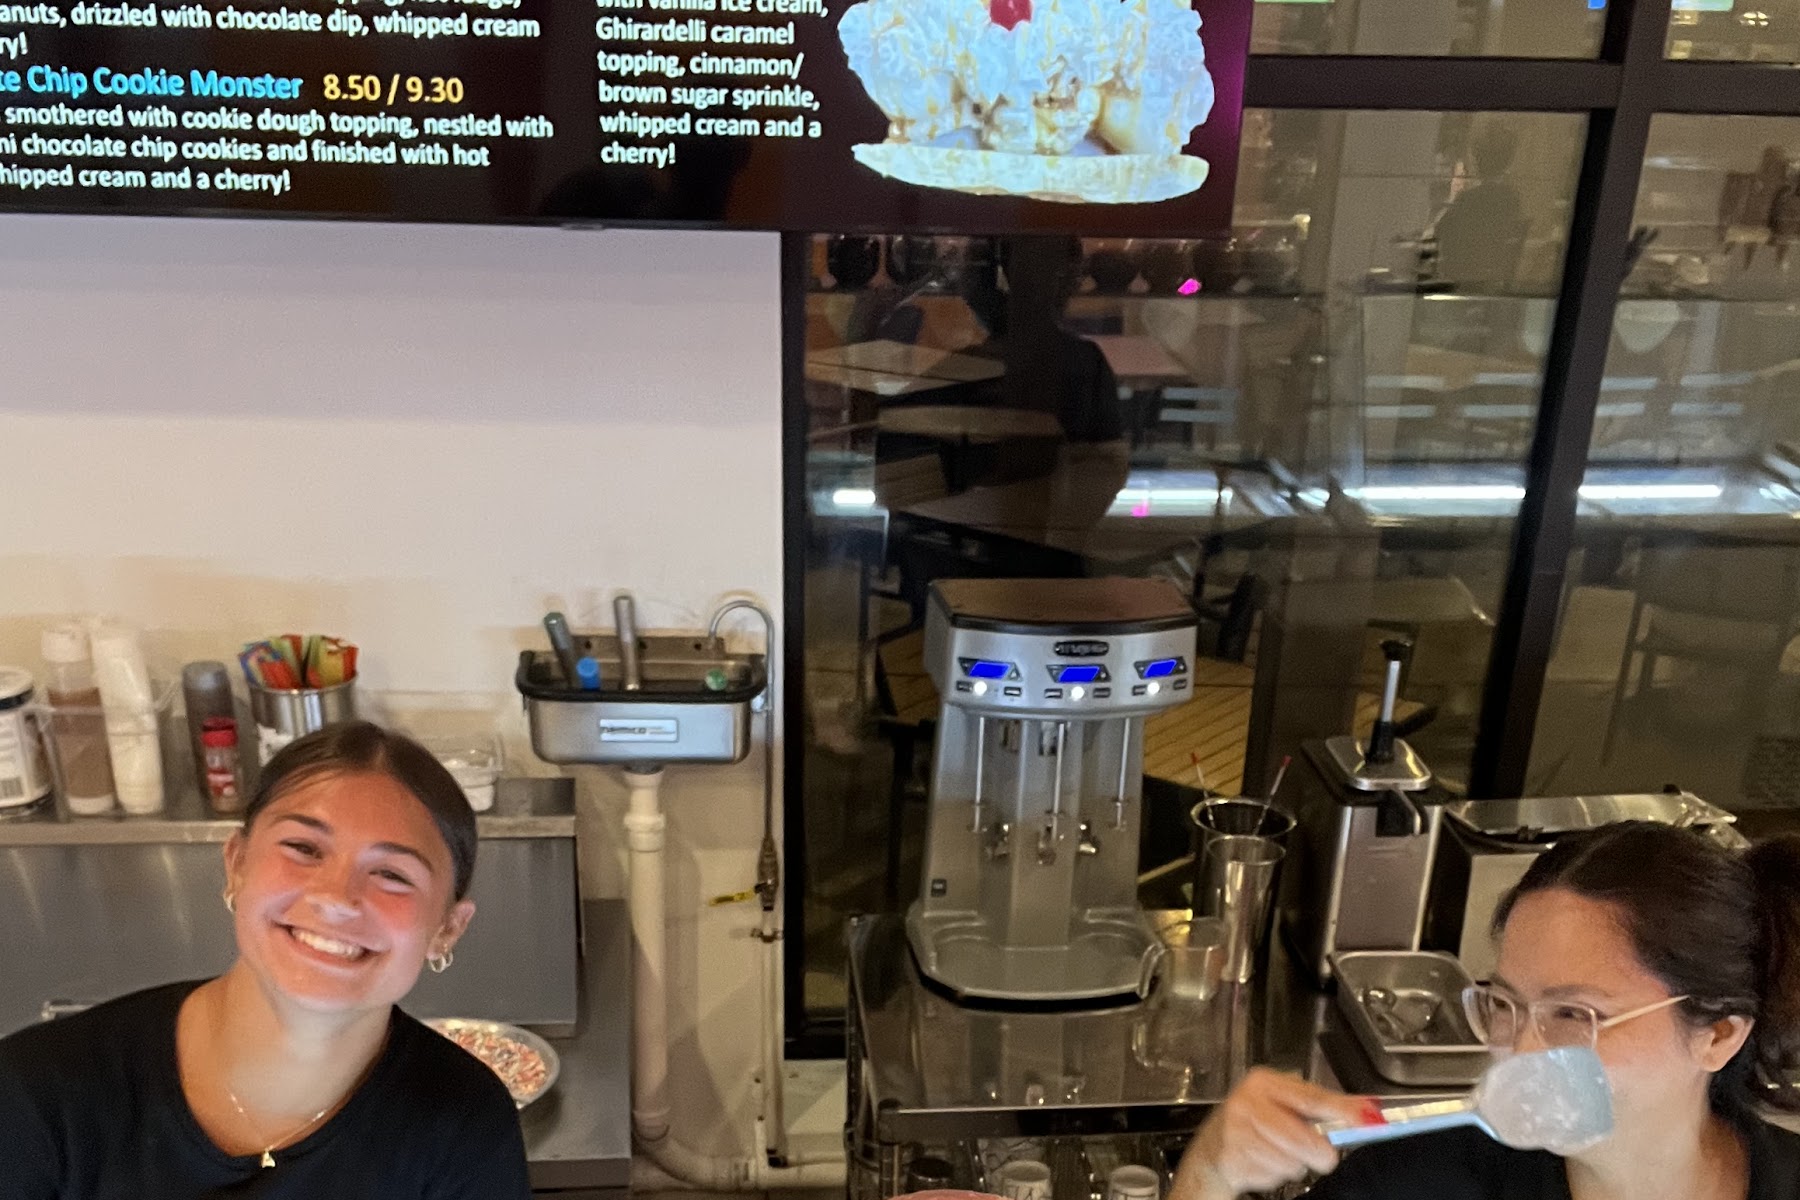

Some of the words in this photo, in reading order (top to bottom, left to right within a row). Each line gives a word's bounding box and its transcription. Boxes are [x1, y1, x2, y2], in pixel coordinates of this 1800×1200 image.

[70, 1, 157, 27] drizzled
[161, 4, 212, 28] with
[216, 5, 322, 31] chocolate
[327, 8, 369, 37] dip,
[373, 10, 468, 39] whipped
[472, 18, 540, 37] cream
[596, 16, 706, 42] Ghirardelli
[710, 21, 795, 44] caramel
[597, 50, 685, 77] topping,
[689, 52, 804, 80] cinnamon/
[27, 64, 88, 99] Chip
[93, 67, 185, 96] Cookie
[190, 69, 303, 99] Monster
[323, 74, 381, 101] 8.50
[386, 73, 400, 105] /
[406, 76, 464, 104] 9.30
[599, 80, 667, 103] brown
[671, 87, 728, 109] sugar
[732, 85, 820, 110] sprinkle,
[5, 102, 124, 127] smothered
[127, 105, 178, 128] with
[181, 106, 253, 129] cookie
[257, 108, 326, 137] dough
[330, 112, 419, 139] topping,
[423, 113, 502, 137] nestled
[505, 115, 554, 137] with
[600, 110, 690, 138] whipped
[694, 117, 759, 136] cream
[764, 116, 803, 137] and
[808, 121, 821, 137] a
[21, 132, 127, 157] chocolate
[131, 134, 177, 162] chip
[181, 137, 263, 160] cookies
[267, 139, 308, 161] and
[311, 139, 397, 163] finished
[400, 143, 449, 165] with
[453, 143, 490, 166] hot
[601, 141, 676, 168] cherry!
[78, 169, 146, 187] cream
[151, 166, 192, 188] and
[196, 171, 210, 189] a
[214, 167, 291, 196] cherry!
